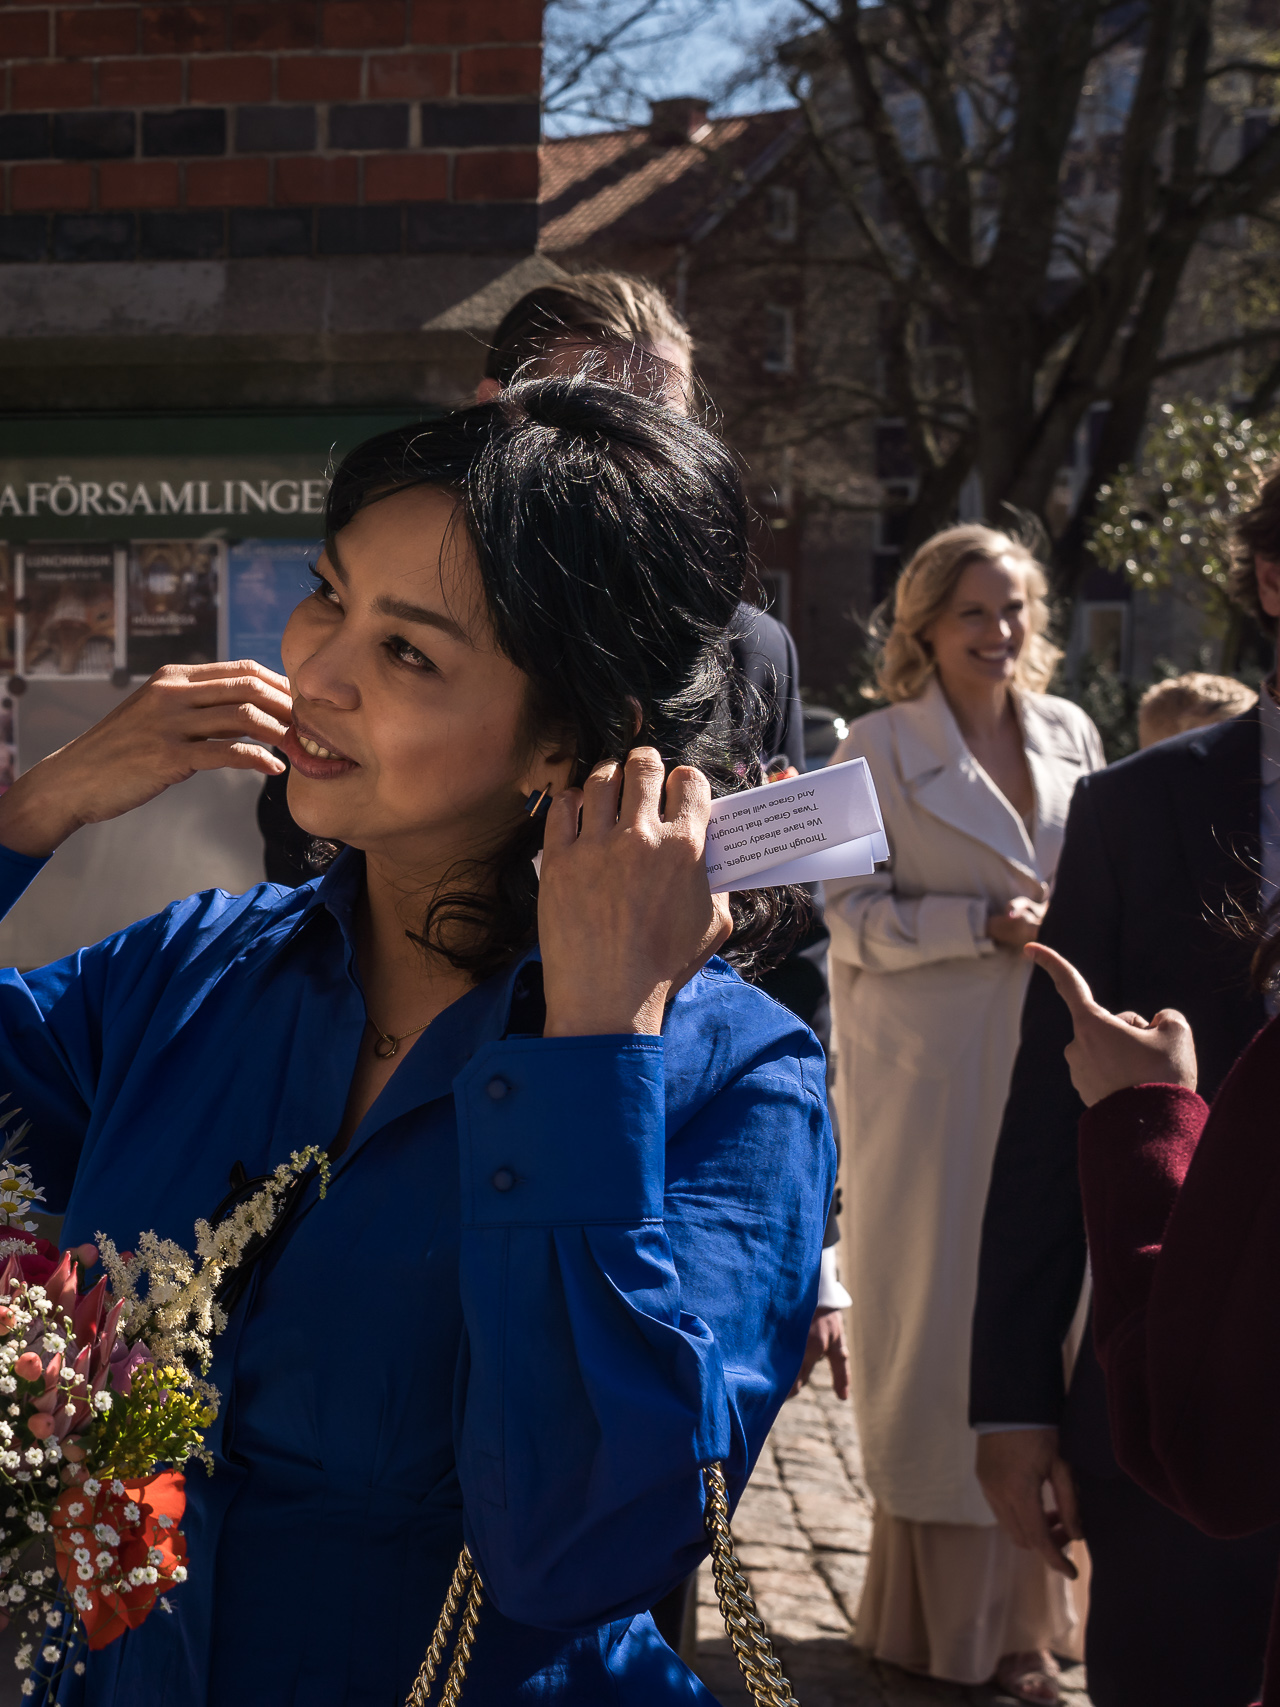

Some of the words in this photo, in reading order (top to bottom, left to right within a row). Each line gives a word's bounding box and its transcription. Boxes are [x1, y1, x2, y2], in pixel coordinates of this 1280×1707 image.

[769, 795, 795, 807] Grace
[797, 789, 815, 801] And
[733, 808, 751, 816] lead
[753, 803, 767, 813] will
[764, 811, 791, 823] Grace
[807, 817, 822, 827] We
[745, 819, 762, 829] that
[783, 822, 805, 834] have
[711, 825, 744, 841] brought
[750, 830, 781, 844] already
[724, 840, 747, 851] come
[790, 833, 827, 849] Through
[764, 844, 787, 856] many
[724, 851, 761, 867] dangers,
